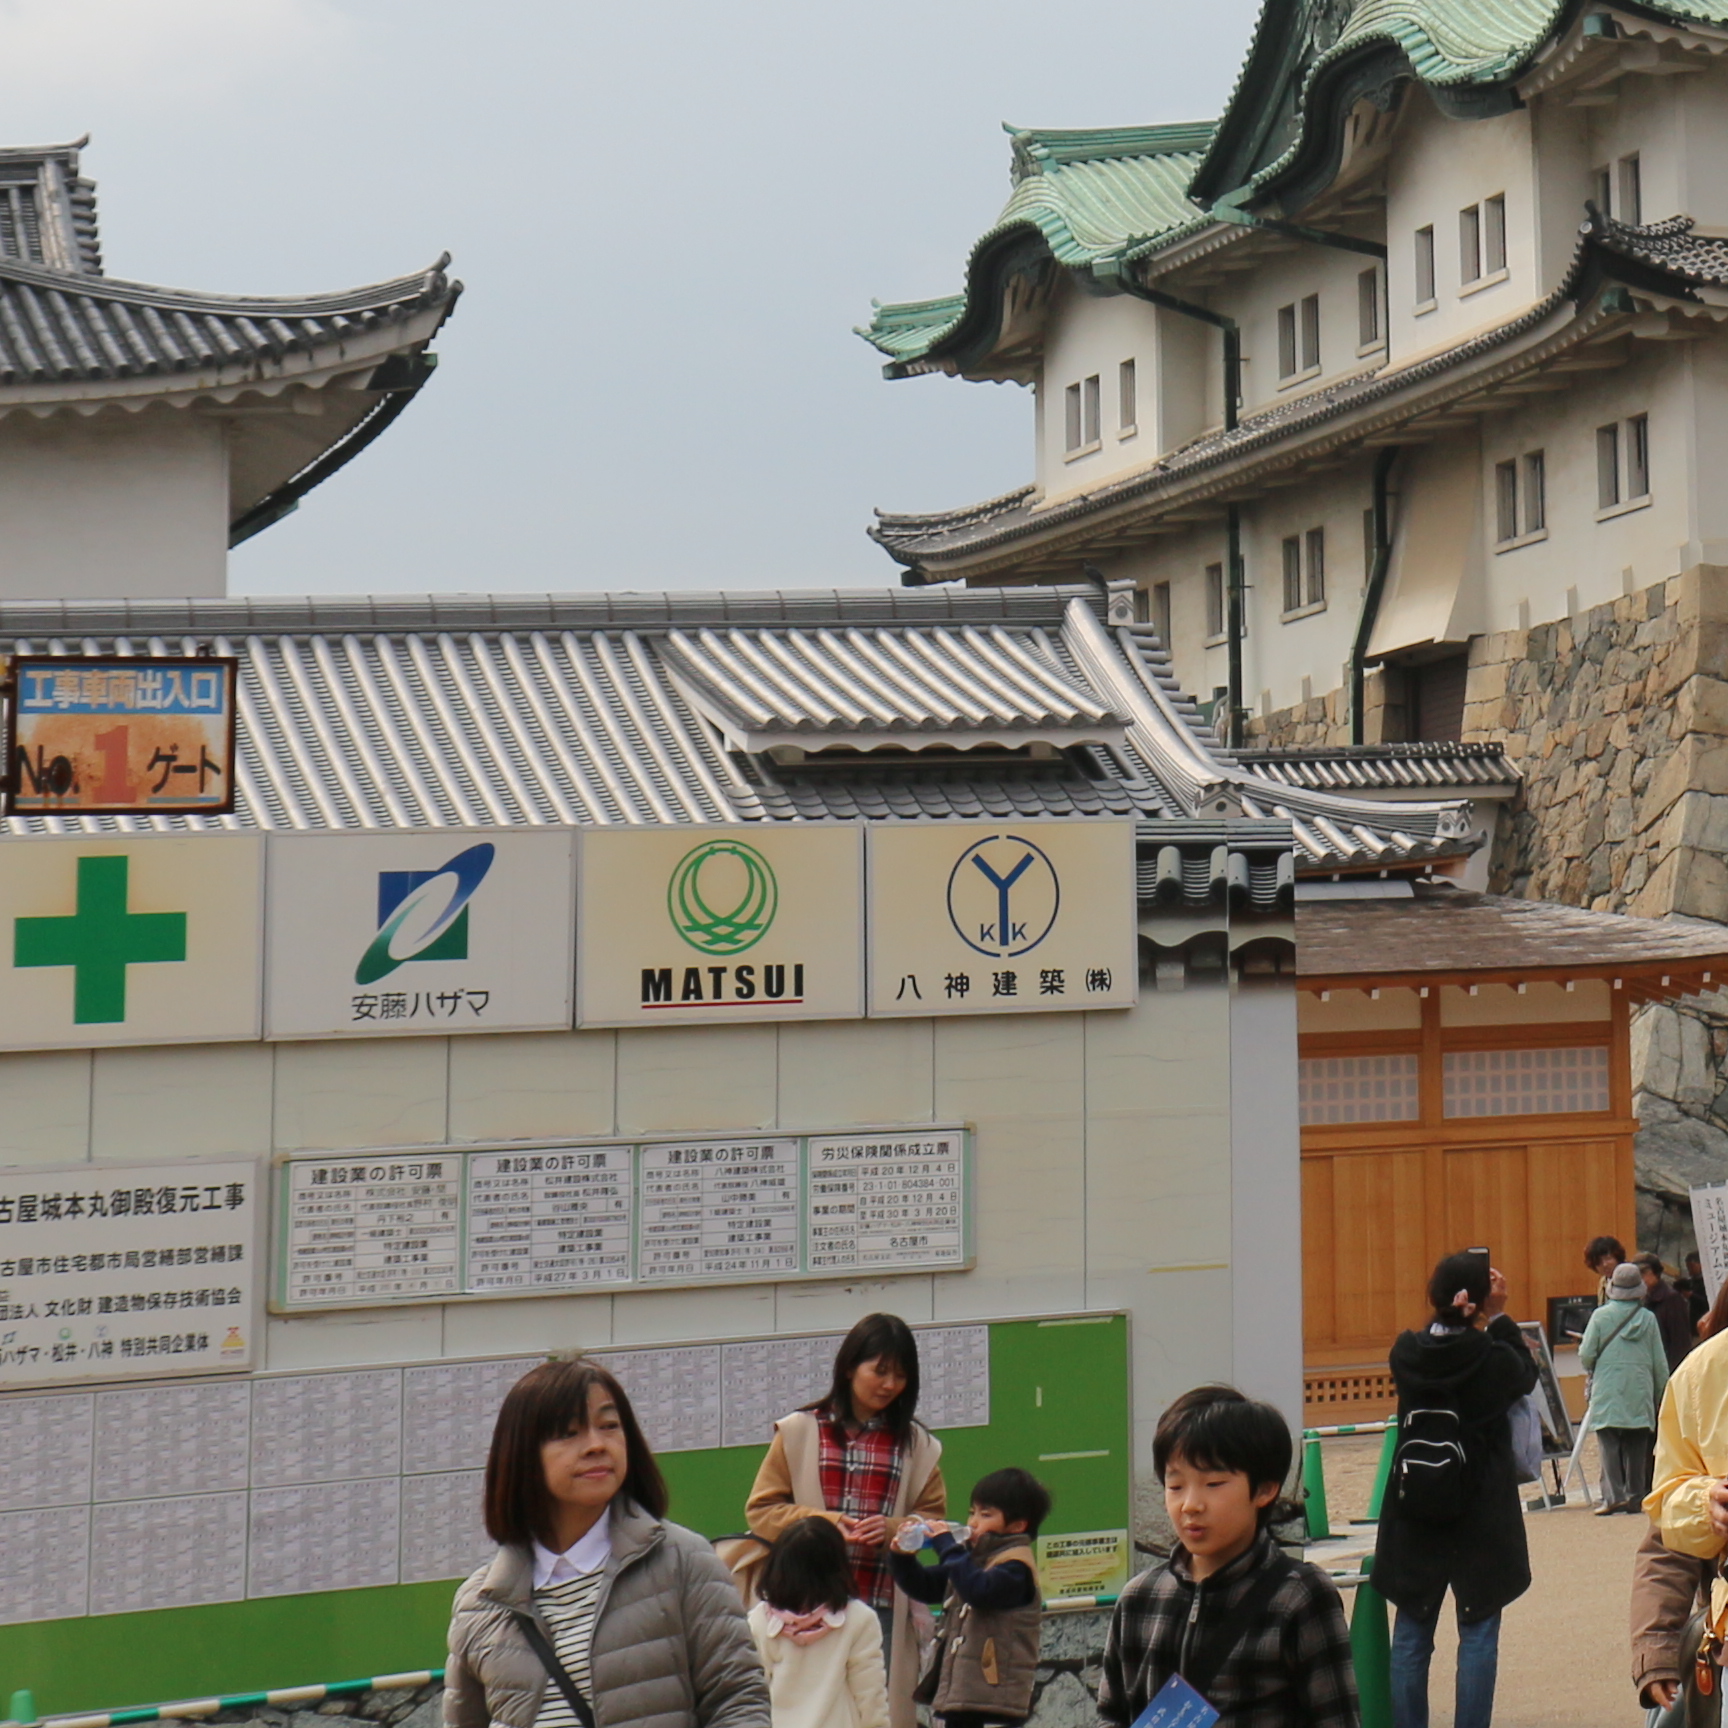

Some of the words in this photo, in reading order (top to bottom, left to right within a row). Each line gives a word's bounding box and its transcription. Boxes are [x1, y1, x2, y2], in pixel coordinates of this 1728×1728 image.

[23, 669, 218, 709] 工事車両出入口
[92, 725, 137, 803] 1
[147, 743, 221, 794] ゲート
[641, 963, 804, 1002] MATSUI
[352, 988, 490, 1021] 安藤ハザマ
[668, 1146, 774, 1164] 建設業の許可票
[821, 1141, 950, 1161] 労災保険関係成立票
[311, 1162, 443, 1185] 建設業の許可票
[497, 1153, 606, 1173] 建設業の許可票
[715, 1165, 785, 1176] 八神建築株式会社
[545, 1173, 618, 1185] 松井建設株式会社
[0, 1182, 245, 1224] 古屋城本丸御殿復元工事
[890, 1236, 928, 1248] 名古屋市
[45, 1298, 92, 1318] 文化財
[98, 1287, 242, 1314] 建造物保存技術協会
